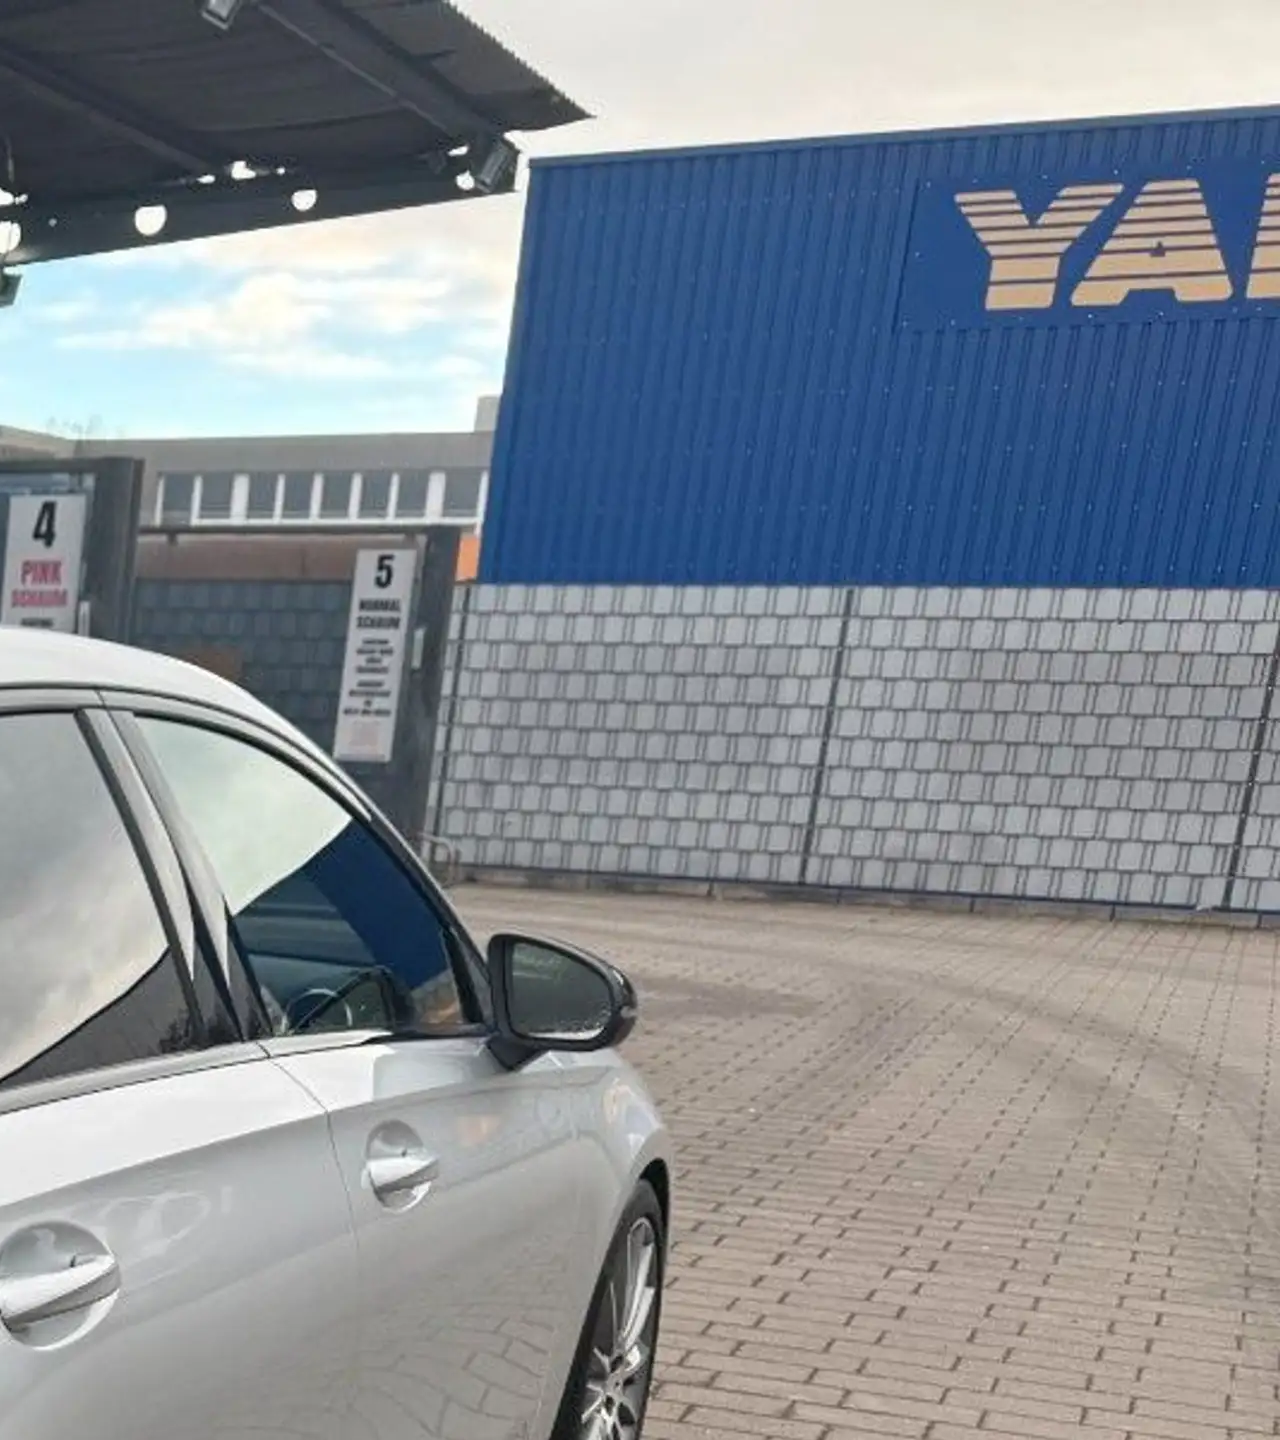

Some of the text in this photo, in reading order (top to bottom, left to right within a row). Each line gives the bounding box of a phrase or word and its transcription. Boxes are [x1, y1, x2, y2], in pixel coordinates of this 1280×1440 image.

[32, 500, 57, 548] 4
[21, 560, 62, 585] PINK
[375, 554, 395, 589] 5
